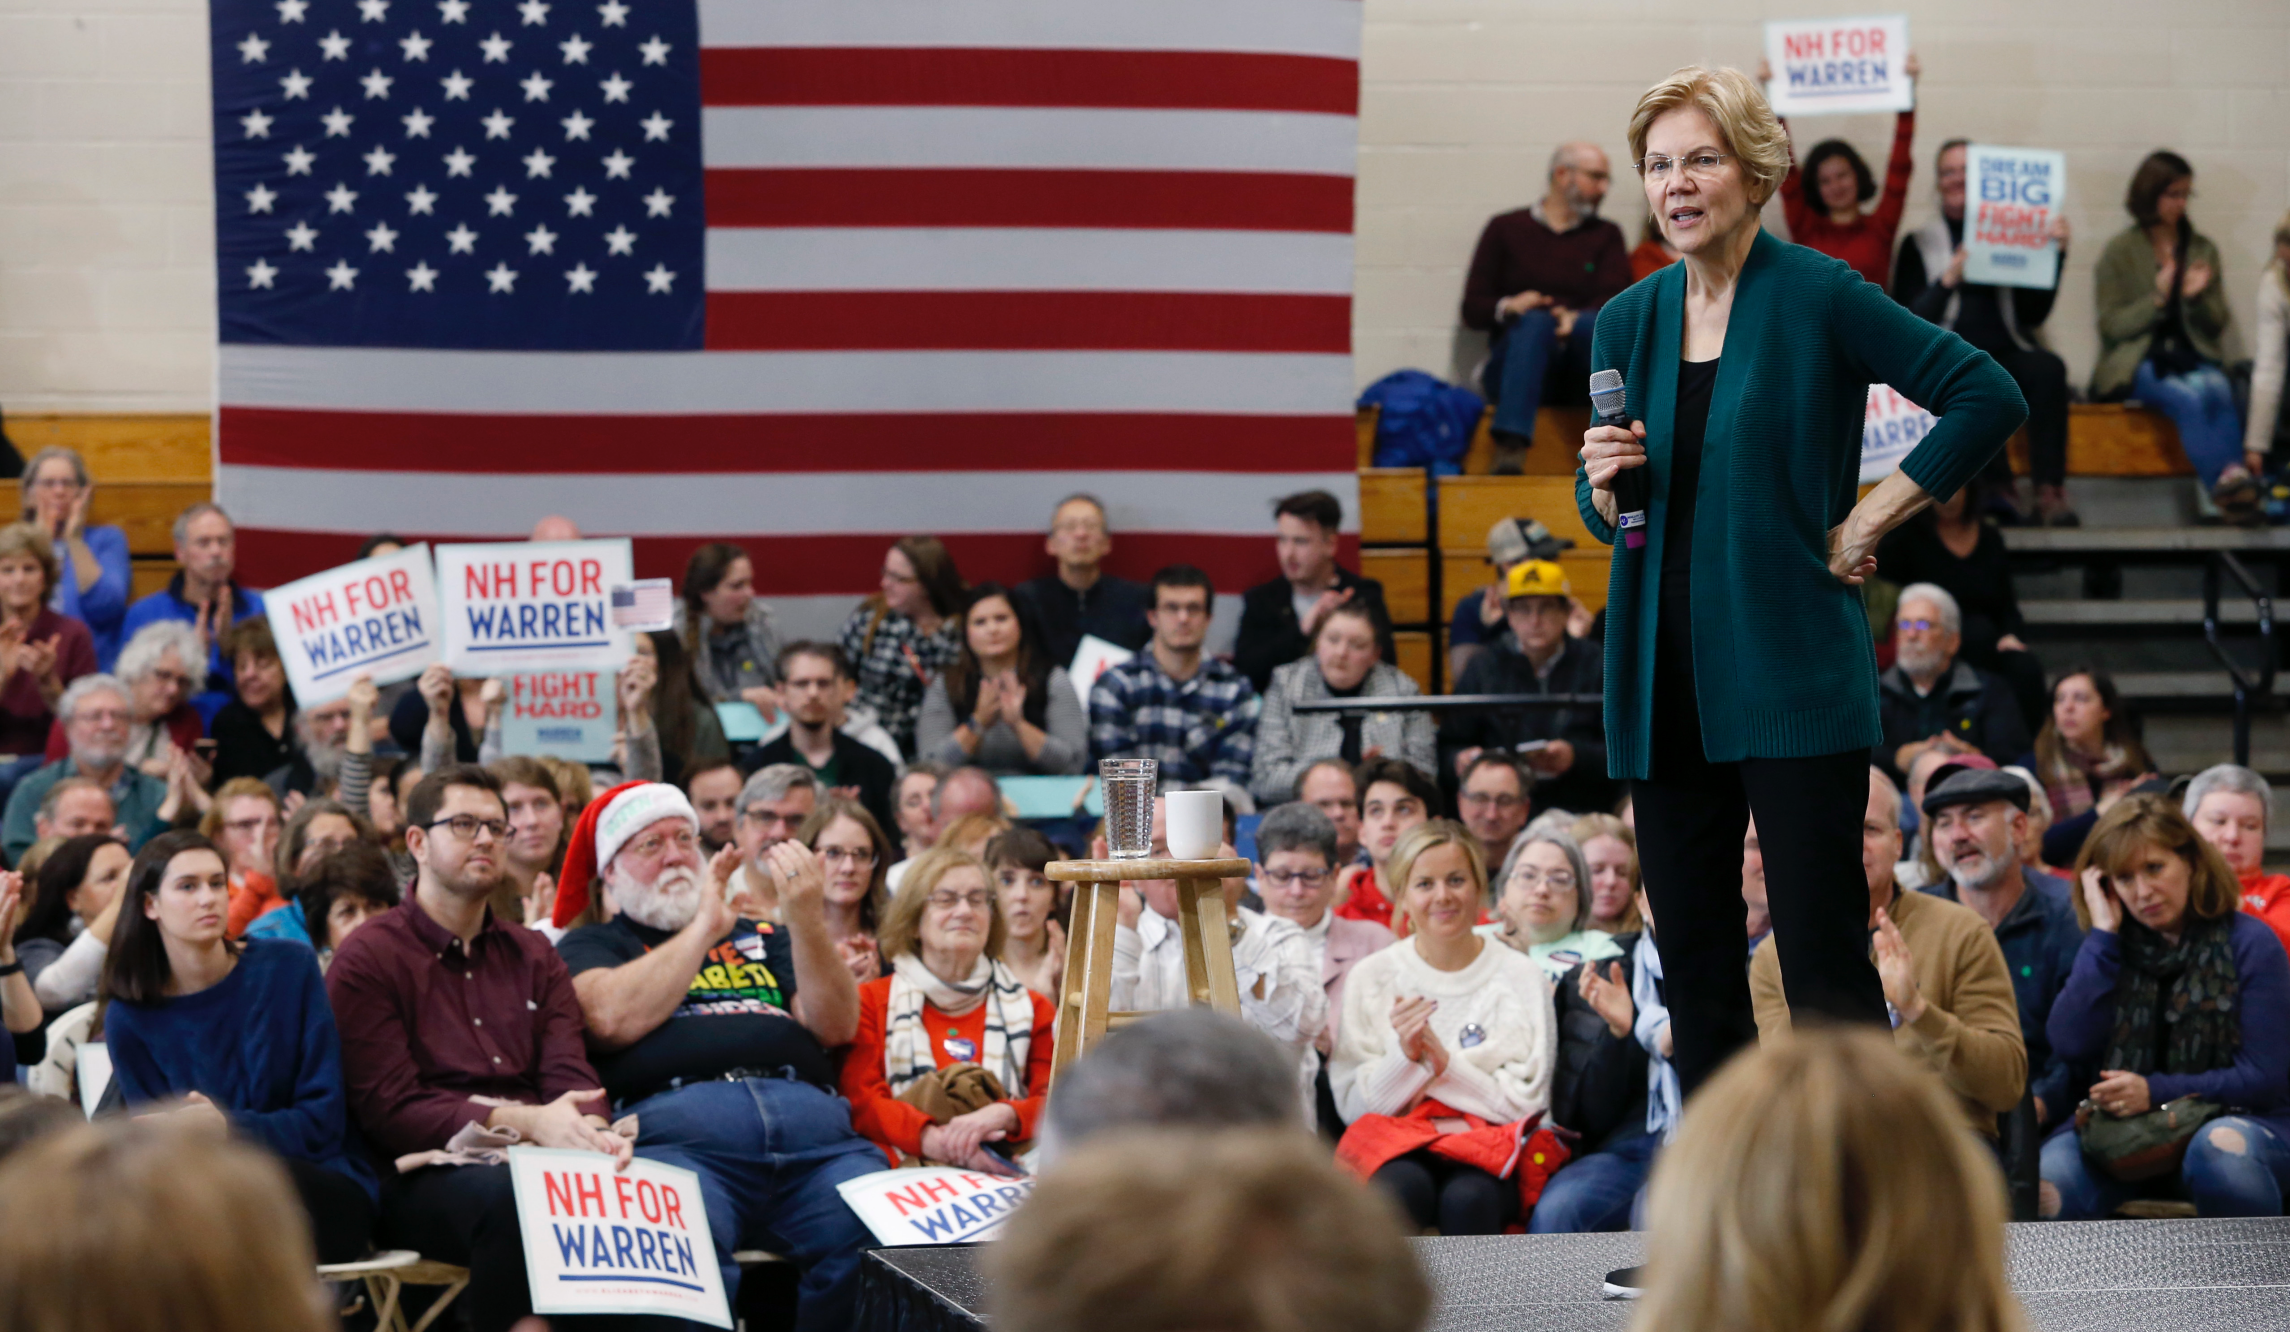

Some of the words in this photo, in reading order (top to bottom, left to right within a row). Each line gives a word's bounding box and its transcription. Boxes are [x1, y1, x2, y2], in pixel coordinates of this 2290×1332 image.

[1784, 32, 1824, 59] NH
[1831, 28, 1886, 57] FOR
[1786, 59, 1888, 87] WARREN
[1979, 156, 2050, 176] DREAM
[1981, 177, 2049, 205] BIG
[1977, 203, 2049, 230] FIGHT
[1863, 414, 1942, 450] ARRE
[465, 562, 516, 599] NH
[530, 559, 602, 597] FOR
[290, 590, 339, 634] NH
[344, 568, 413, 617] FOR
[302, 605, 423, 668] WARREN
[467, 601, 605, 639] WARREN
[513, 671, 599, 698] FIGHT
[514, 700, 602, 720] HARD
[543, 1171, 607, 1218] NH
[614, 1175, 687, 1230] FOR
[884, 1177, 959, 1216] NH
[909, 1182, 1036, 1242] WARR
[552, 1223, 698, 1279] WARREN
